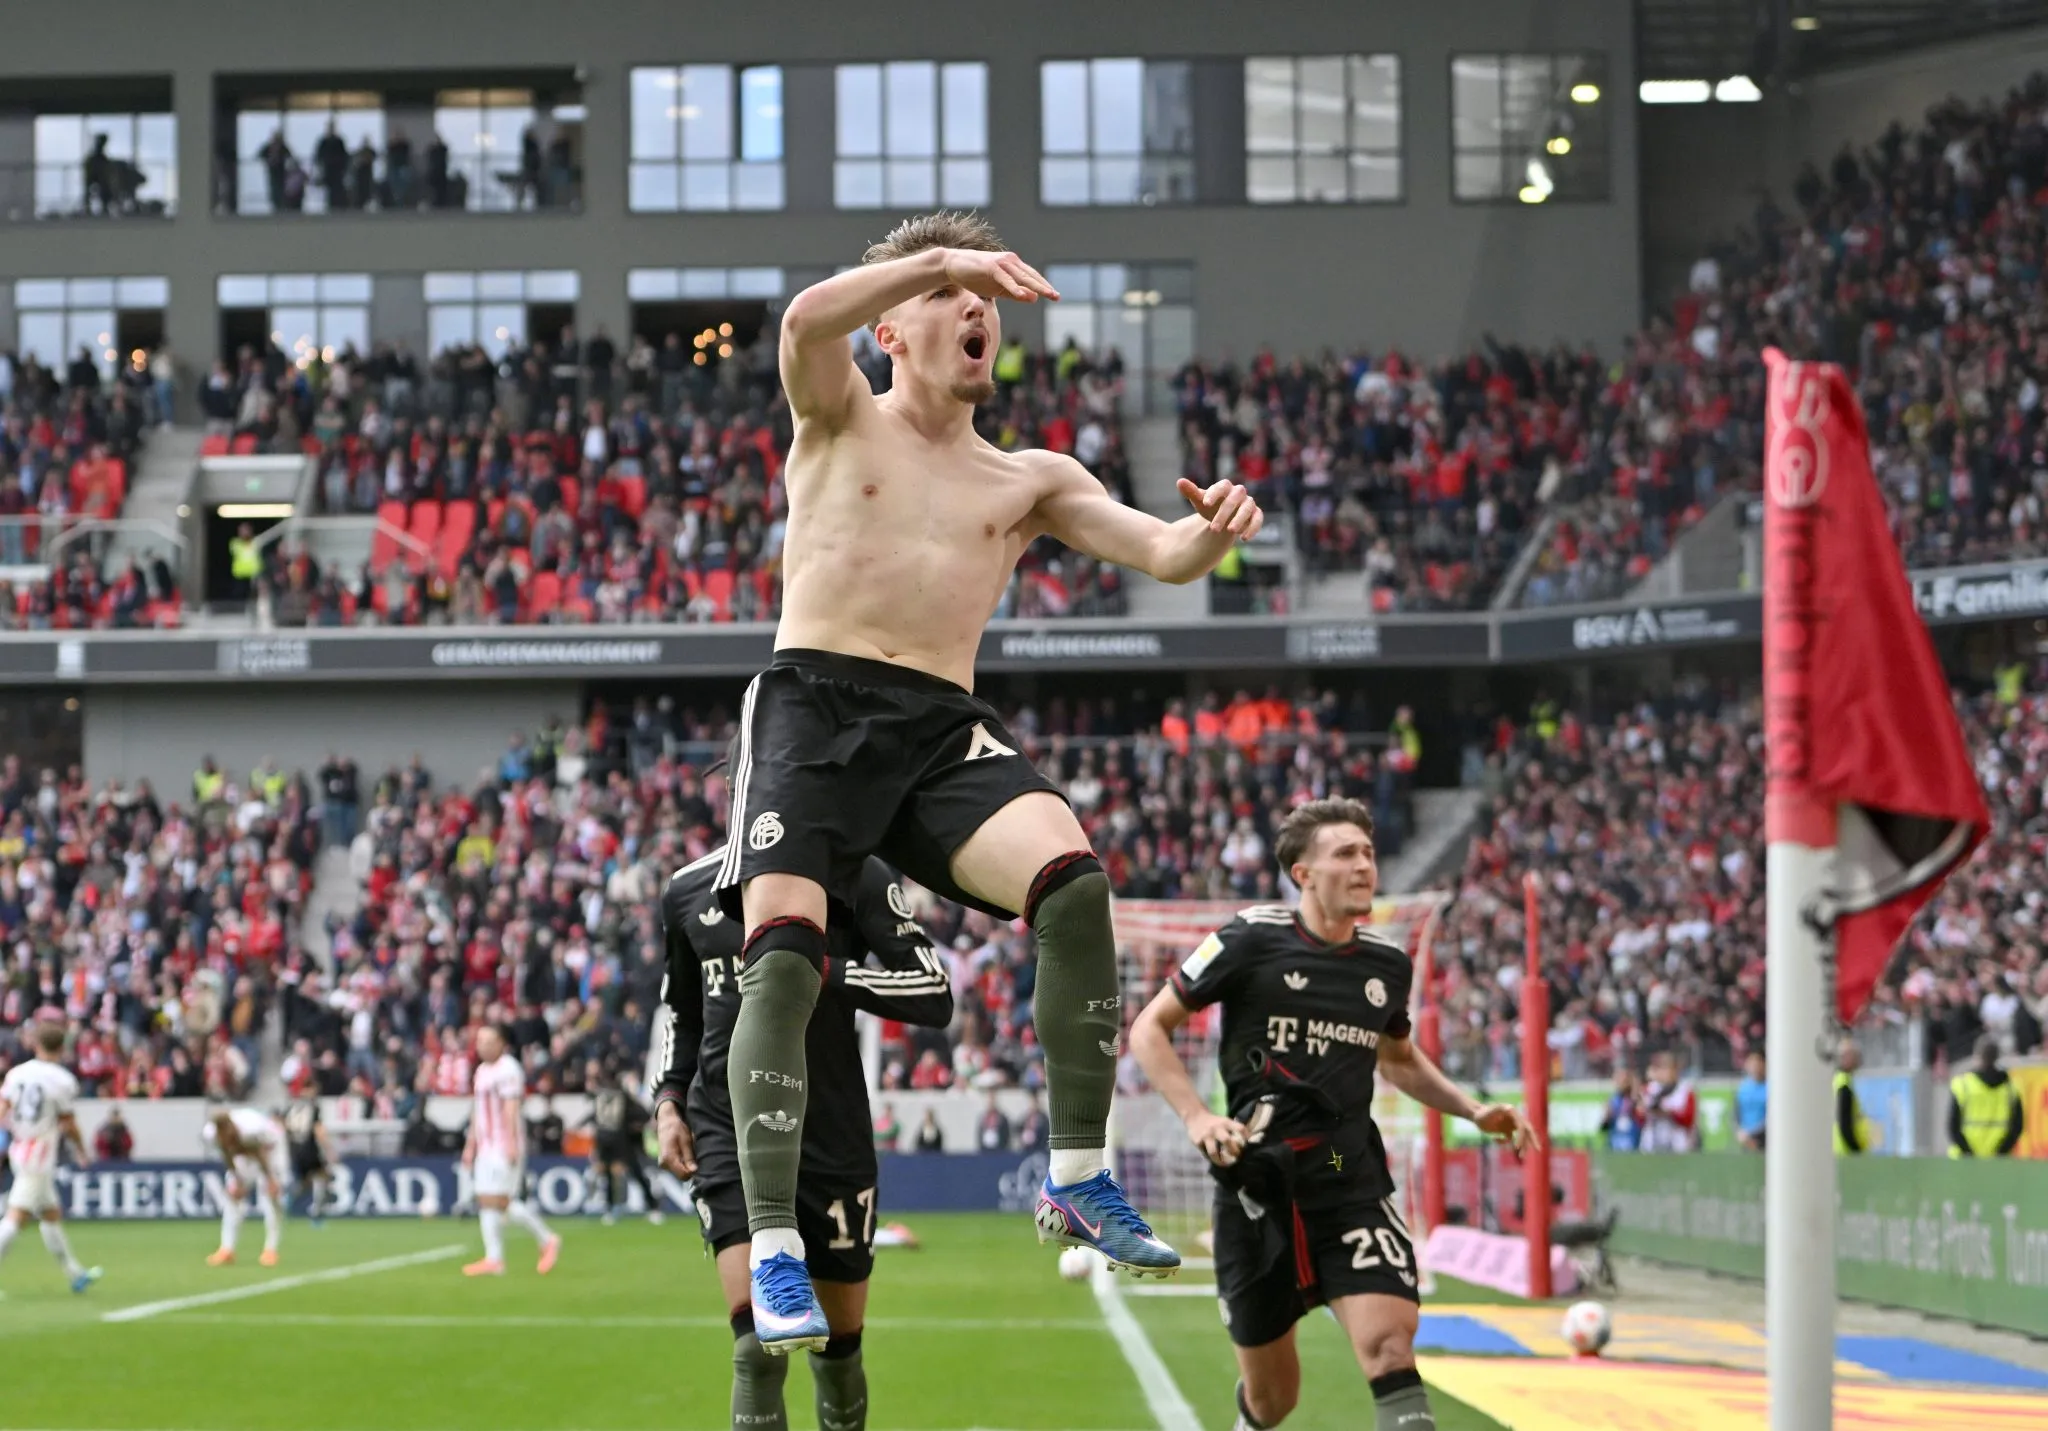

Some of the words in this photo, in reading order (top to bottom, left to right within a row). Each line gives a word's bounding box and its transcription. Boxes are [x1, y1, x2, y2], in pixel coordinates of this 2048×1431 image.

[1305, 1037, 1330, 1057] TV
[749, 1070, 803, 1093] FCBM
[309, 1163, 440, 1217] BAD
[1341, 1226, 1408, 1270] 20
